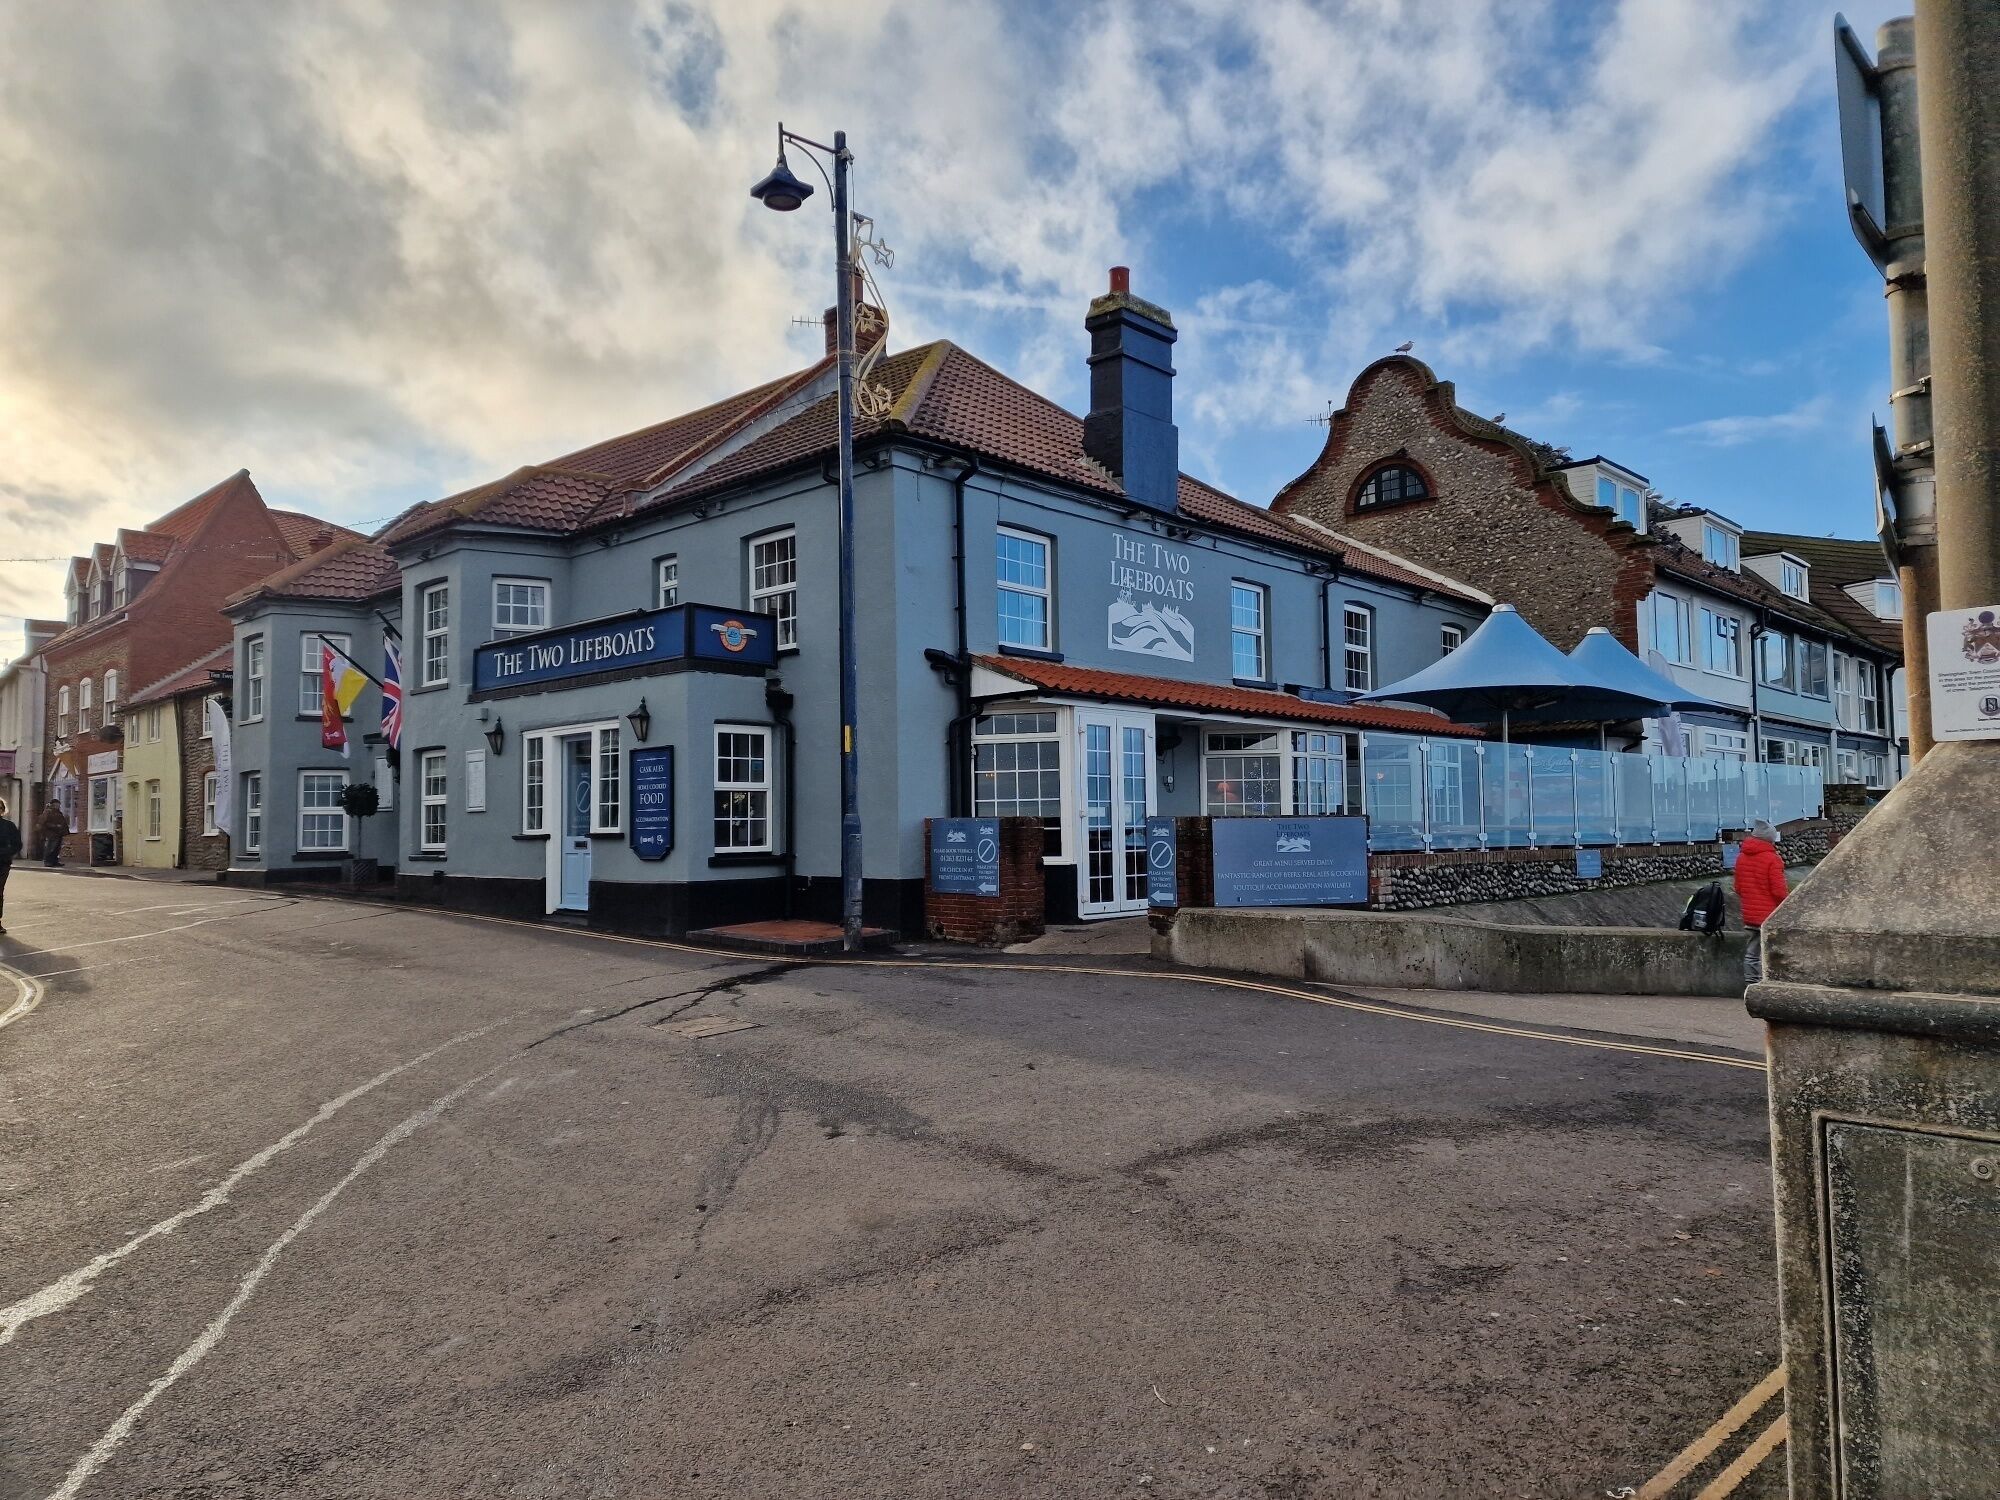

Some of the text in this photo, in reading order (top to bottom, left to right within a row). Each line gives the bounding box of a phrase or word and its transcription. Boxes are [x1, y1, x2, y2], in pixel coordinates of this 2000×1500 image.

[1112, 532, 1190, 574] THE TWO
[1110, 560, 1195, 602] LIFEBOATS
[494, 626, 655, 678] THE TWO LIFEBOATS
[639, 766, 653, 774] CASK
[639, 793, 664, 805] FOOD
[1217, 872, 1250, 880] FANTASTIC
[1232, 884, 1265, 892] BOUTIQUE
[1267, 882, 1323, 890] ACCOMMODATION
